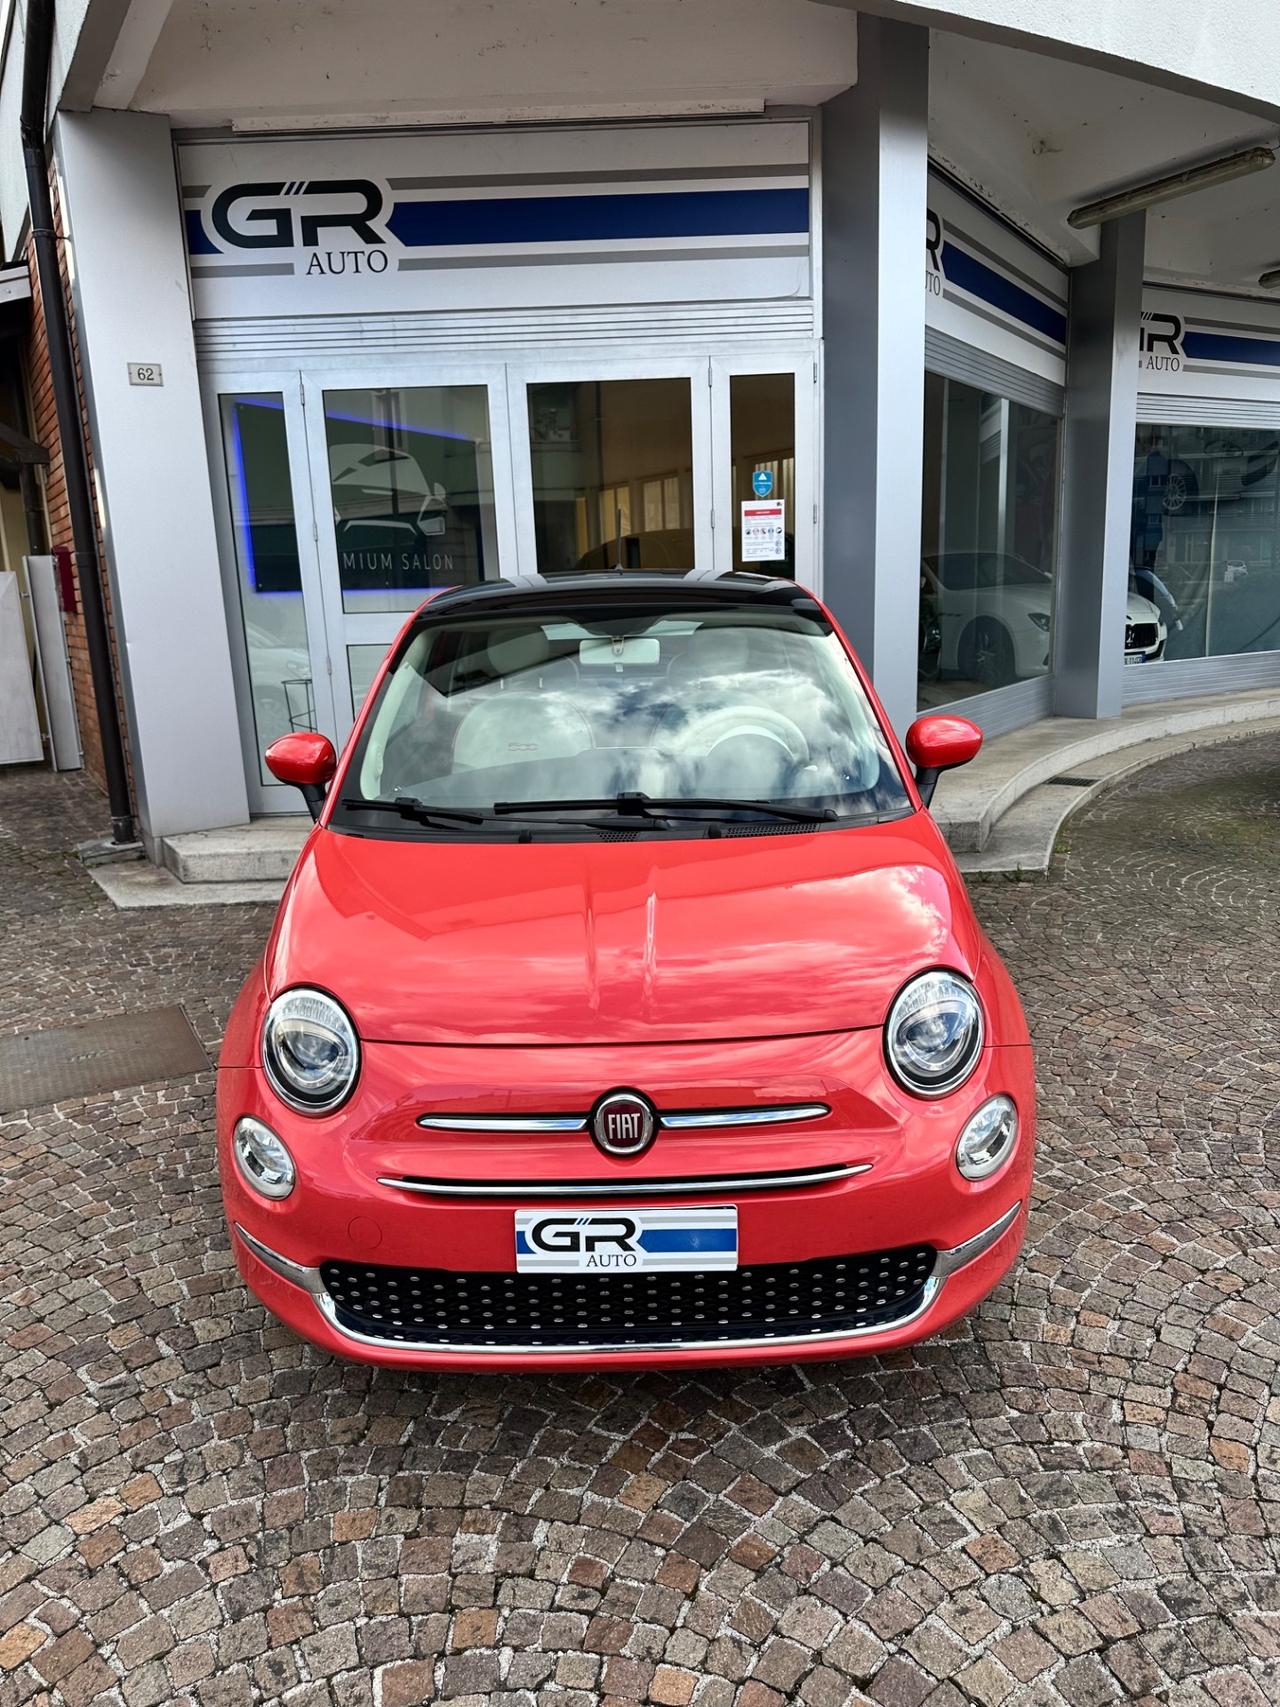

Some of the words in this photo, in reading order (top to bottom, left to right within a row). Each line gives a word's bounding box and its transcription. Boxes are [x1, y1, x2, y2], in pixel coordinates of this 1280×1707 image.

[211, 178, 386, 249] GR
[926, 207, 941, 272] R
[305, 249, 389, 275] AUTO
[925, 270, 941, 295] TO
[1140, 311, 1182, 355] R
[137, 367, 155, 381] 62
[1146, 355, 1180, 372] AUTO
[343, 553, 393, 570] MIUM
[401, 553, 453, 570] SALON
[607, 1112, 641, 1140] FIAT
[531, 1217, 637, 1253] GR
[586, 1253, 637, 1268] AUTO
